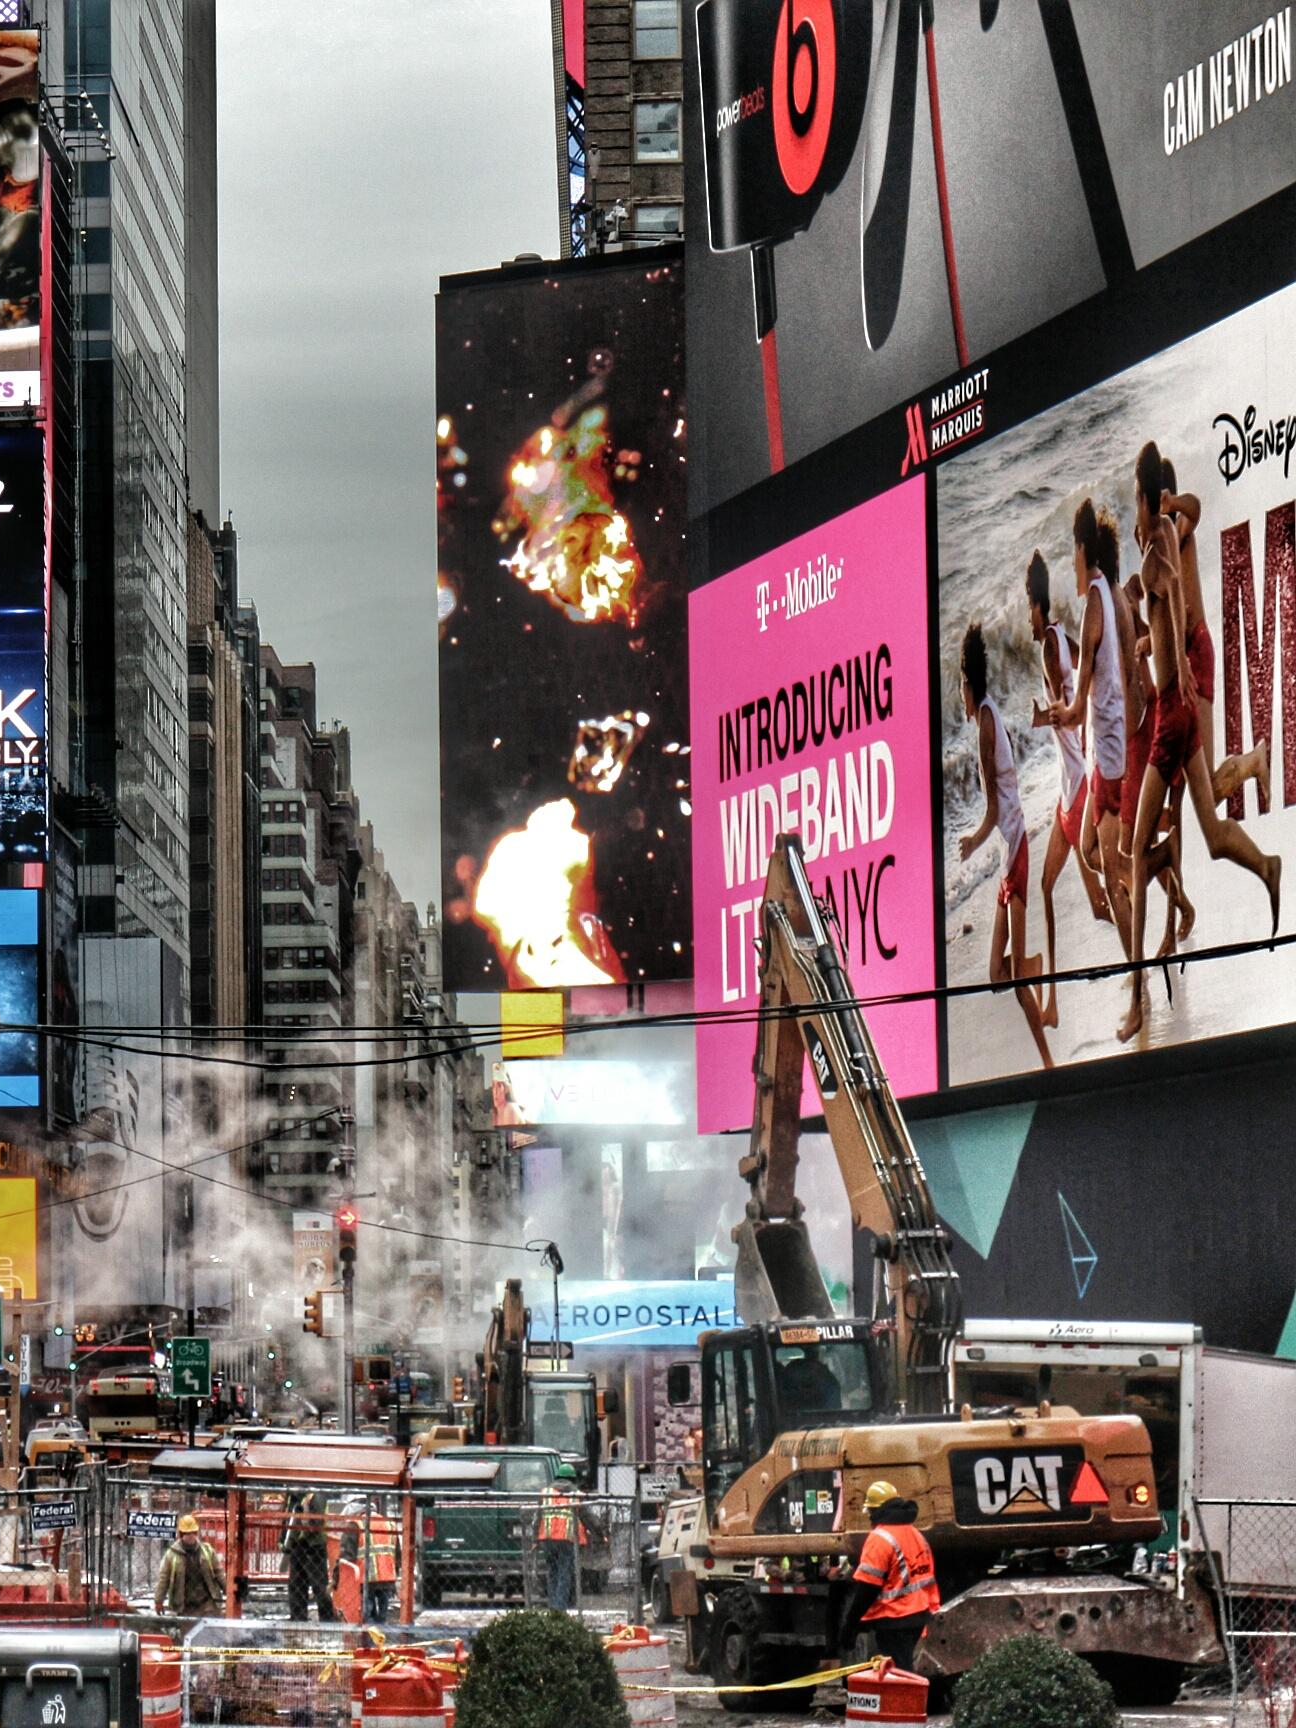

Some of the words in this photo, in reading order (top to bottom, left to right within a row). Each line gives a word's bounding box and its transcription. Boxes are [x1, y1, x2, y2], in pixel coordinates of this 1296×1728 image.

[1163, 65, 1203, 157] CAM
[1209, 6, 1293, 131] NEWTON
[716, 85, 765, 139] powerbeats
[930, 368, 990, 417] MARRIOTT
[930, 404, 985, 451] MARQUIS
[718, 643, 894, 783] INTRODUCING
[719, 740, 895, 890] WIDEBAND
[1065, 1323, 1095, 1335] Aero
[176, 1358, 207, 1368] Broadway
[973, 1456, 1063, 1515] CAT
[33, 1504, 74, 1517] Federal
[128, 1513, 176, 1527] Federal
[789, 1501, 804, 1526] CAT
[40, 1669, 68, 1677] TRASH
[848, 1695, 879, 1709] ATIONS
